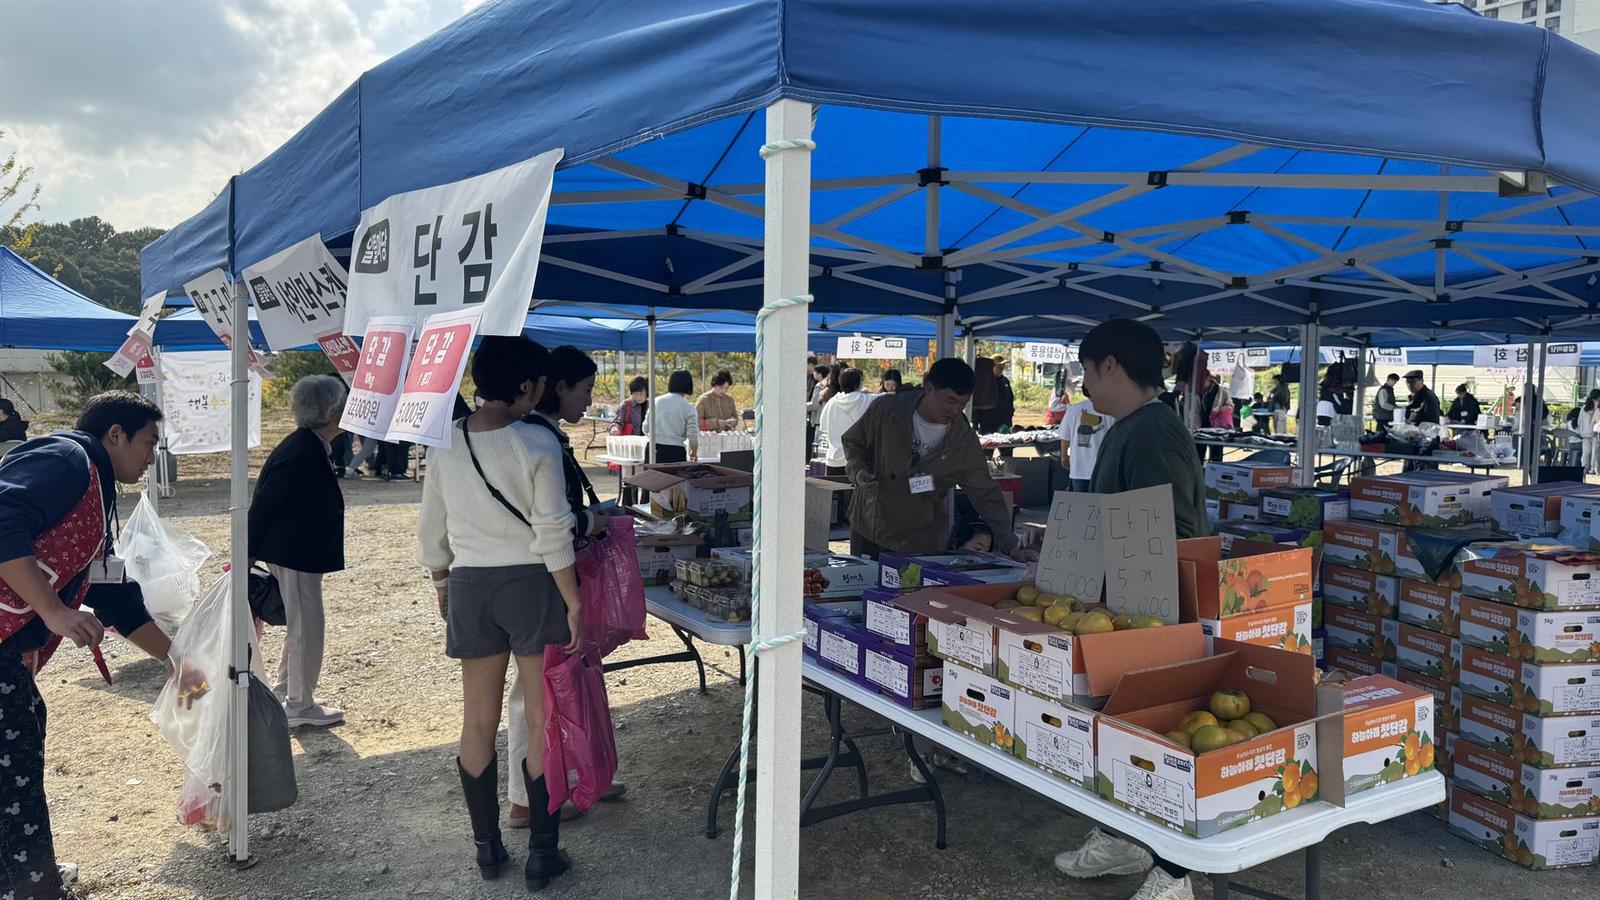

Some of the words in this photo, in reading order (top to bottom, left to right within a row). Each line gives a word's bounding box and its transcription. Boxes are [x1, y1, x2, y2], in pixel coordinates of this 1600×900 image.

[366, 336, 391, 367] 단감
[421, 331, 454, 366] 단감
[1054, 502, 1102, 540] 단감
[1108, 508, 1163, 559] 단감
[1262, 621, 1288, 639] 첫단감
[977, 702, 998, 719] 첫단감
[1351, 726, 1380, 743] 하늘아래
[1380, 719, 1408, 739] 첫단감
[1221, 758, 1254, 779] 하늘아래
[1254, 747, 1286, 772] 첫단감
